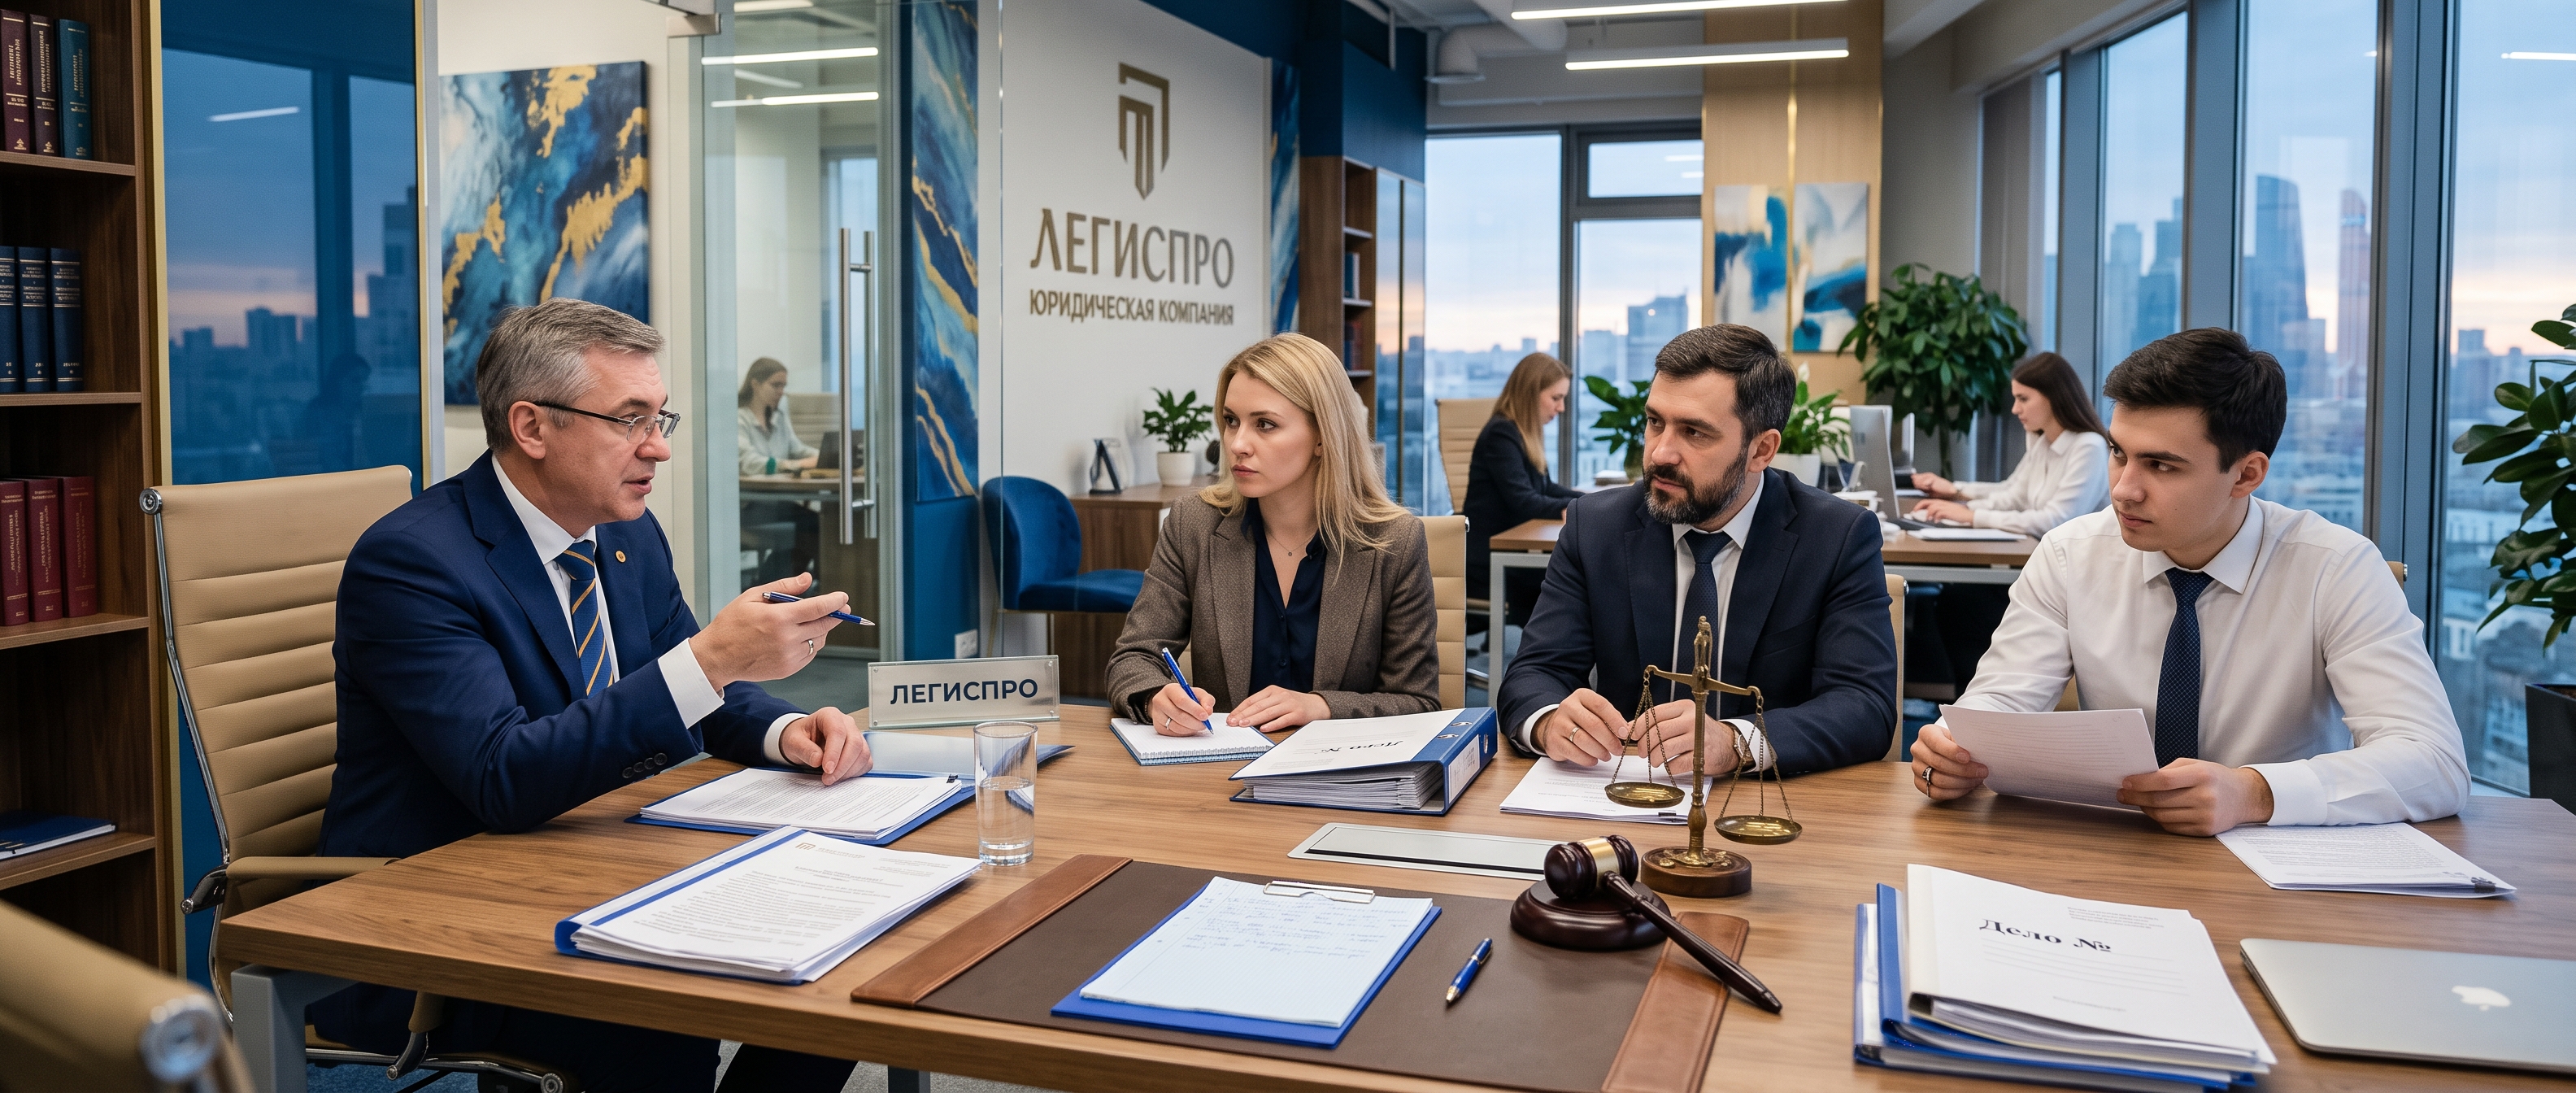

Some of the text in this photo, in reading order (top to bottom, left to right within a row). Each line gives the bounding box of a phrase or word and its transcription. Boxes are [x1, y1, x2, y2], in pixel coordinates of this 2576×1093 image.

[1029, 207, 1234, 289] ЛЕГИСПРО
[1029, 290, 1234, 326] ЮРИДИЧЕСКАЯ КОМПАНИЯ
[890, 678, 1038, 705] ЛЕГИСПРО
[1978, 918, 2061, 944] Дело
[2073, 937, 2112, 953] №
